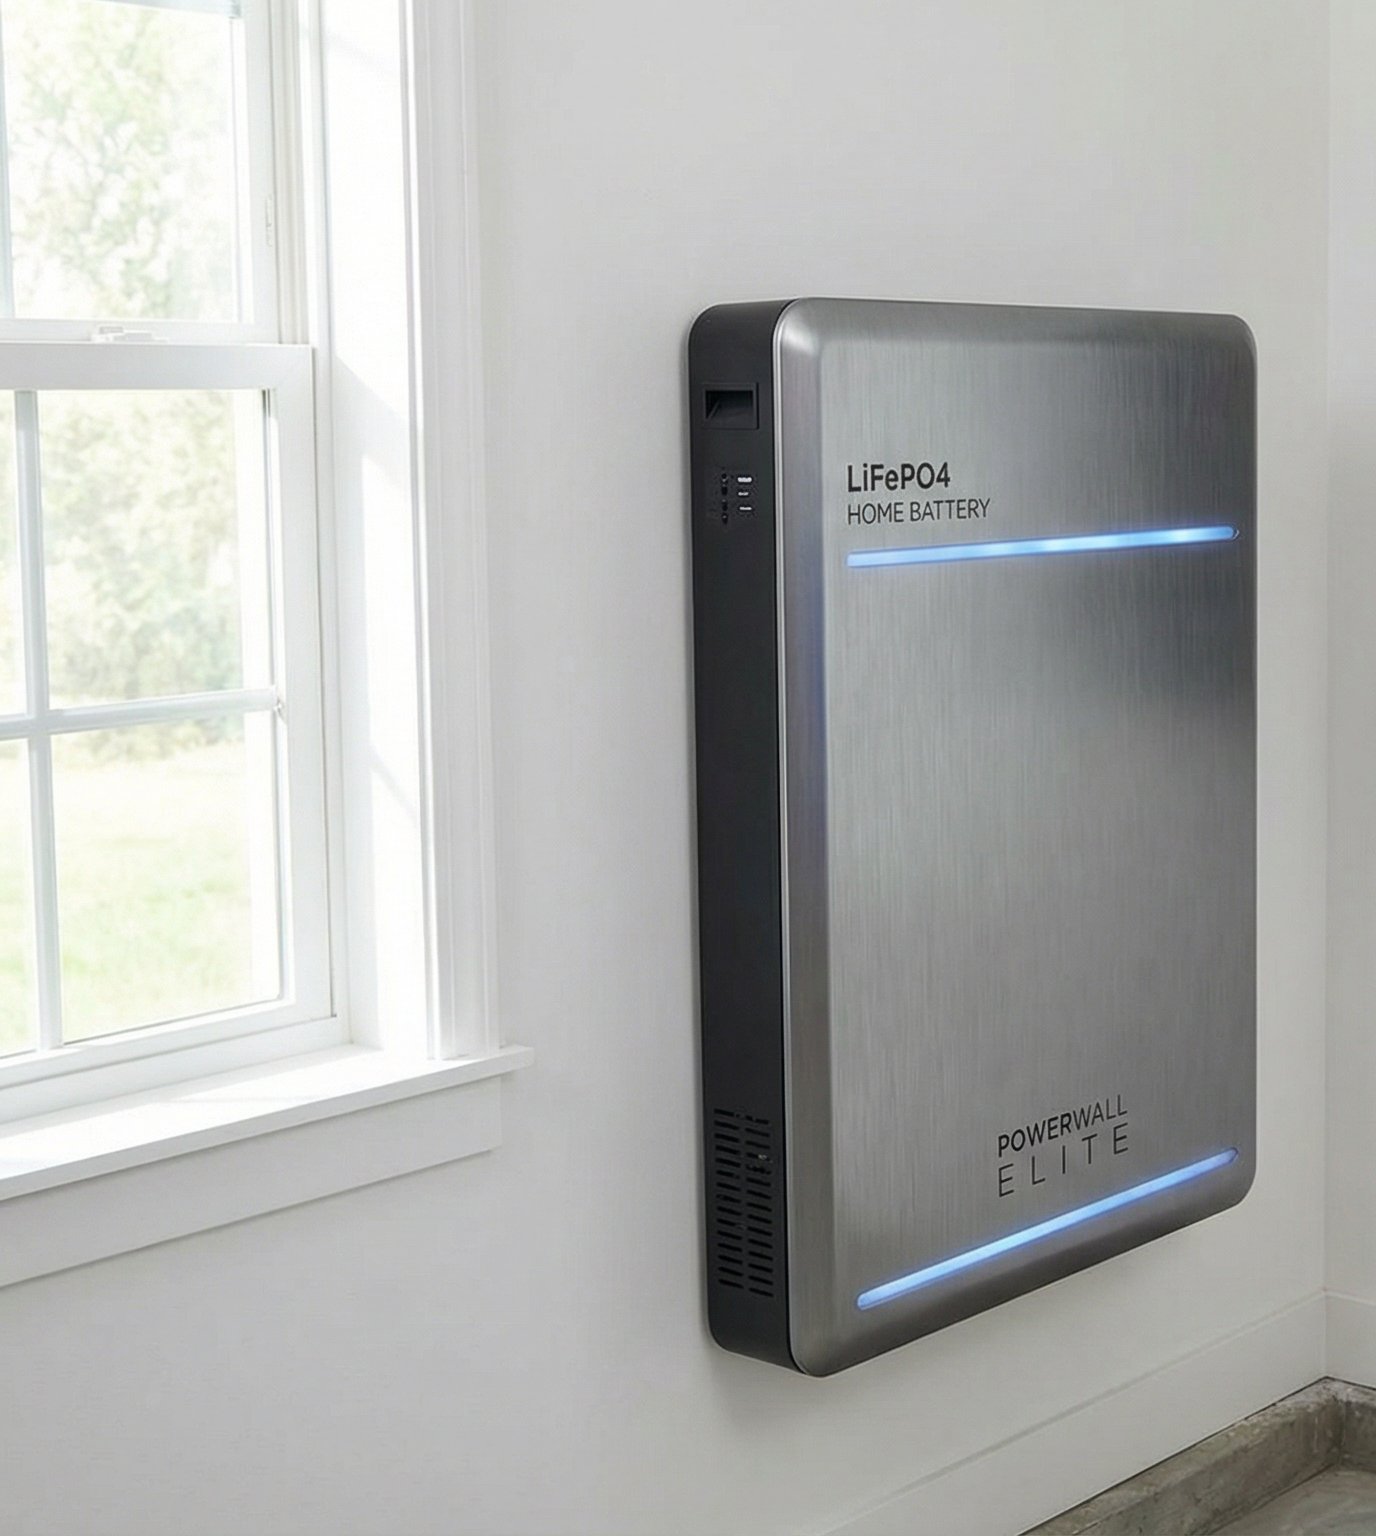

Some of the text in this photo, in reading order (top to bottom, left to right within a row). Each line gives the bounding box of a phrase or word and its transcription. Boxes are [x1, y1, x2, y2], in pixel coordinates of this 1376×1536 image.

[847, 462, 951, 493] LiFePO4
[847, 498, 991, 526] HOME BATTERY
[997, 1094, 1128, 1158] POWERWALL
[997, 1122, 1129, 1198] ELITE
